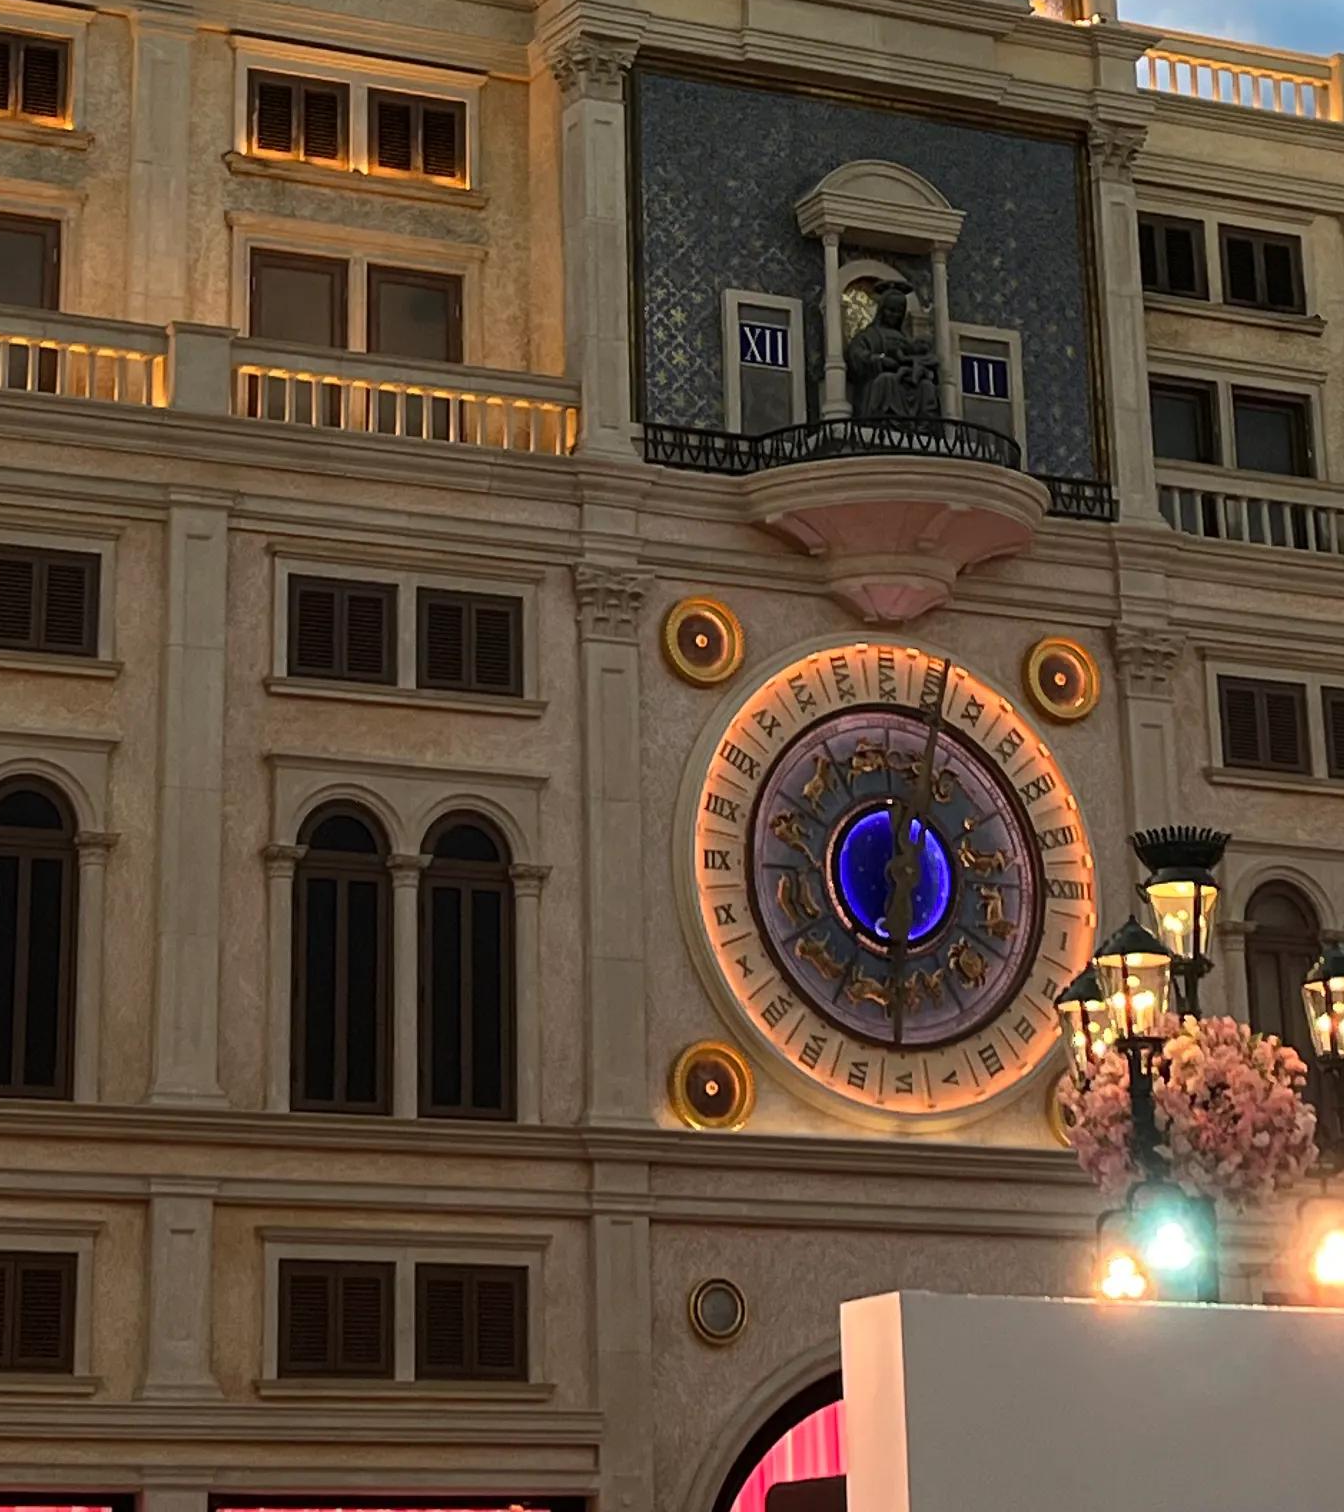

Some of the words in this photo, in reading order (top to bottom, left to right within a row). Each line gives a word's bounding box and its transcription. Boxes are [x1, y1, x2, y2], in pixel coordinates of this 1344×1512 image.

[743, 326, 783, 365] XII
[787, 672, 816, 713] XVI
[830, 655, 855, 701] XVII
[752, 709, 781, 738] XV
[961, 694, 984, 727] XX
[719, 740, 760, 780] XIIII
[996, 727, 1024, 764] XXI
[1018, 772, 1056, 805] XXII
[704, 792, 740, 823] XIII
[704, 849, 731, 871] XII
[713, 903, 737, 926] XI
[735, 955, 754, 979] X
[1013, 1016, 1037, 1044] III
[847, 1060, 868, 1090] VII
[895, 1073, 913, 1094] VI
[942, 1070, 960, 1086] V
